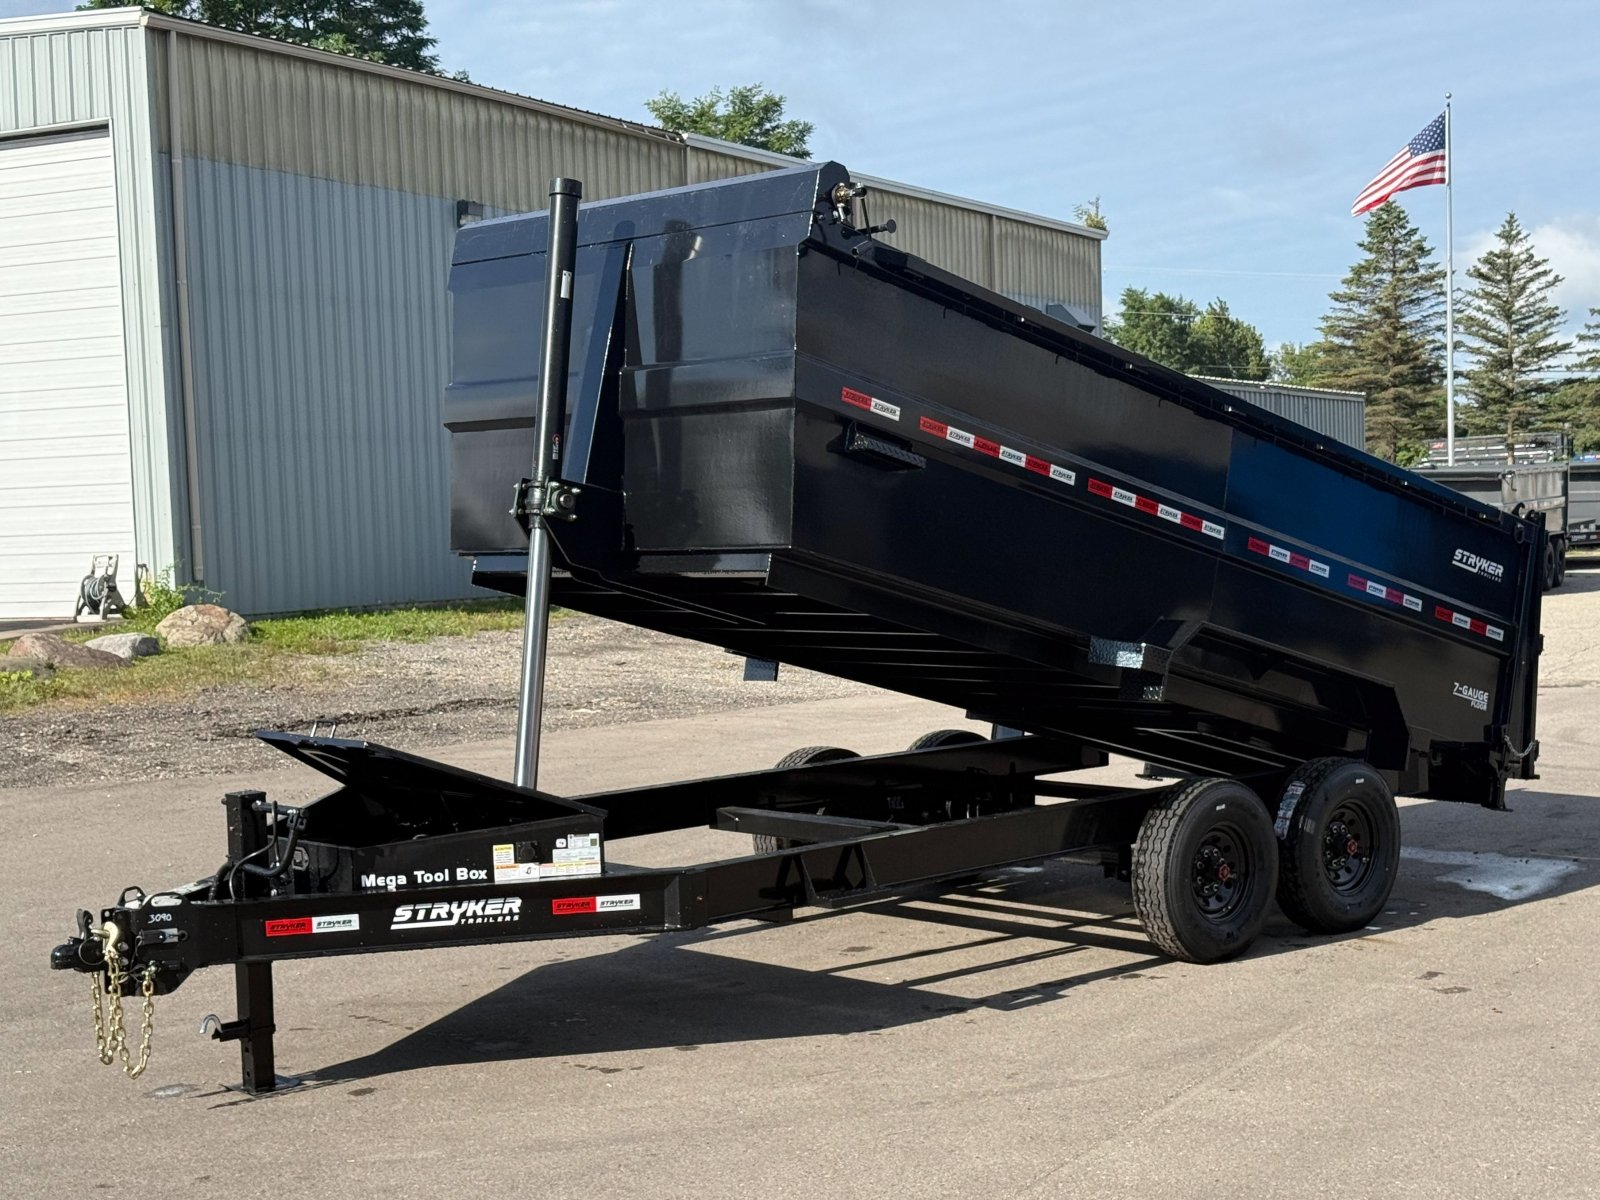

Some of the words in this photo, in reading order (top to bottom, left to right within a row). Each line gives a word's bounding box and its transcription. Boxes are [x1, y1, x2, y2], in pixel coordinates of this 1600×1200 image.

[1452, 548, 1504, 577] STRYKER
[1453, 682, 1489, 702] 7-GAUGE
[361, 873, 407, 892] Mega
[413, 868, 450, 884] Tool
[456, 867, 488, 881] Box
[600, 898, 634, 908] STRYKER
[147, 913, 173, 924] 3090
[391, 896, 522, 930] STRYKER
[460, 915, 520, 925] TRAILERS
[316, 919, 353, 930] STRYKER
